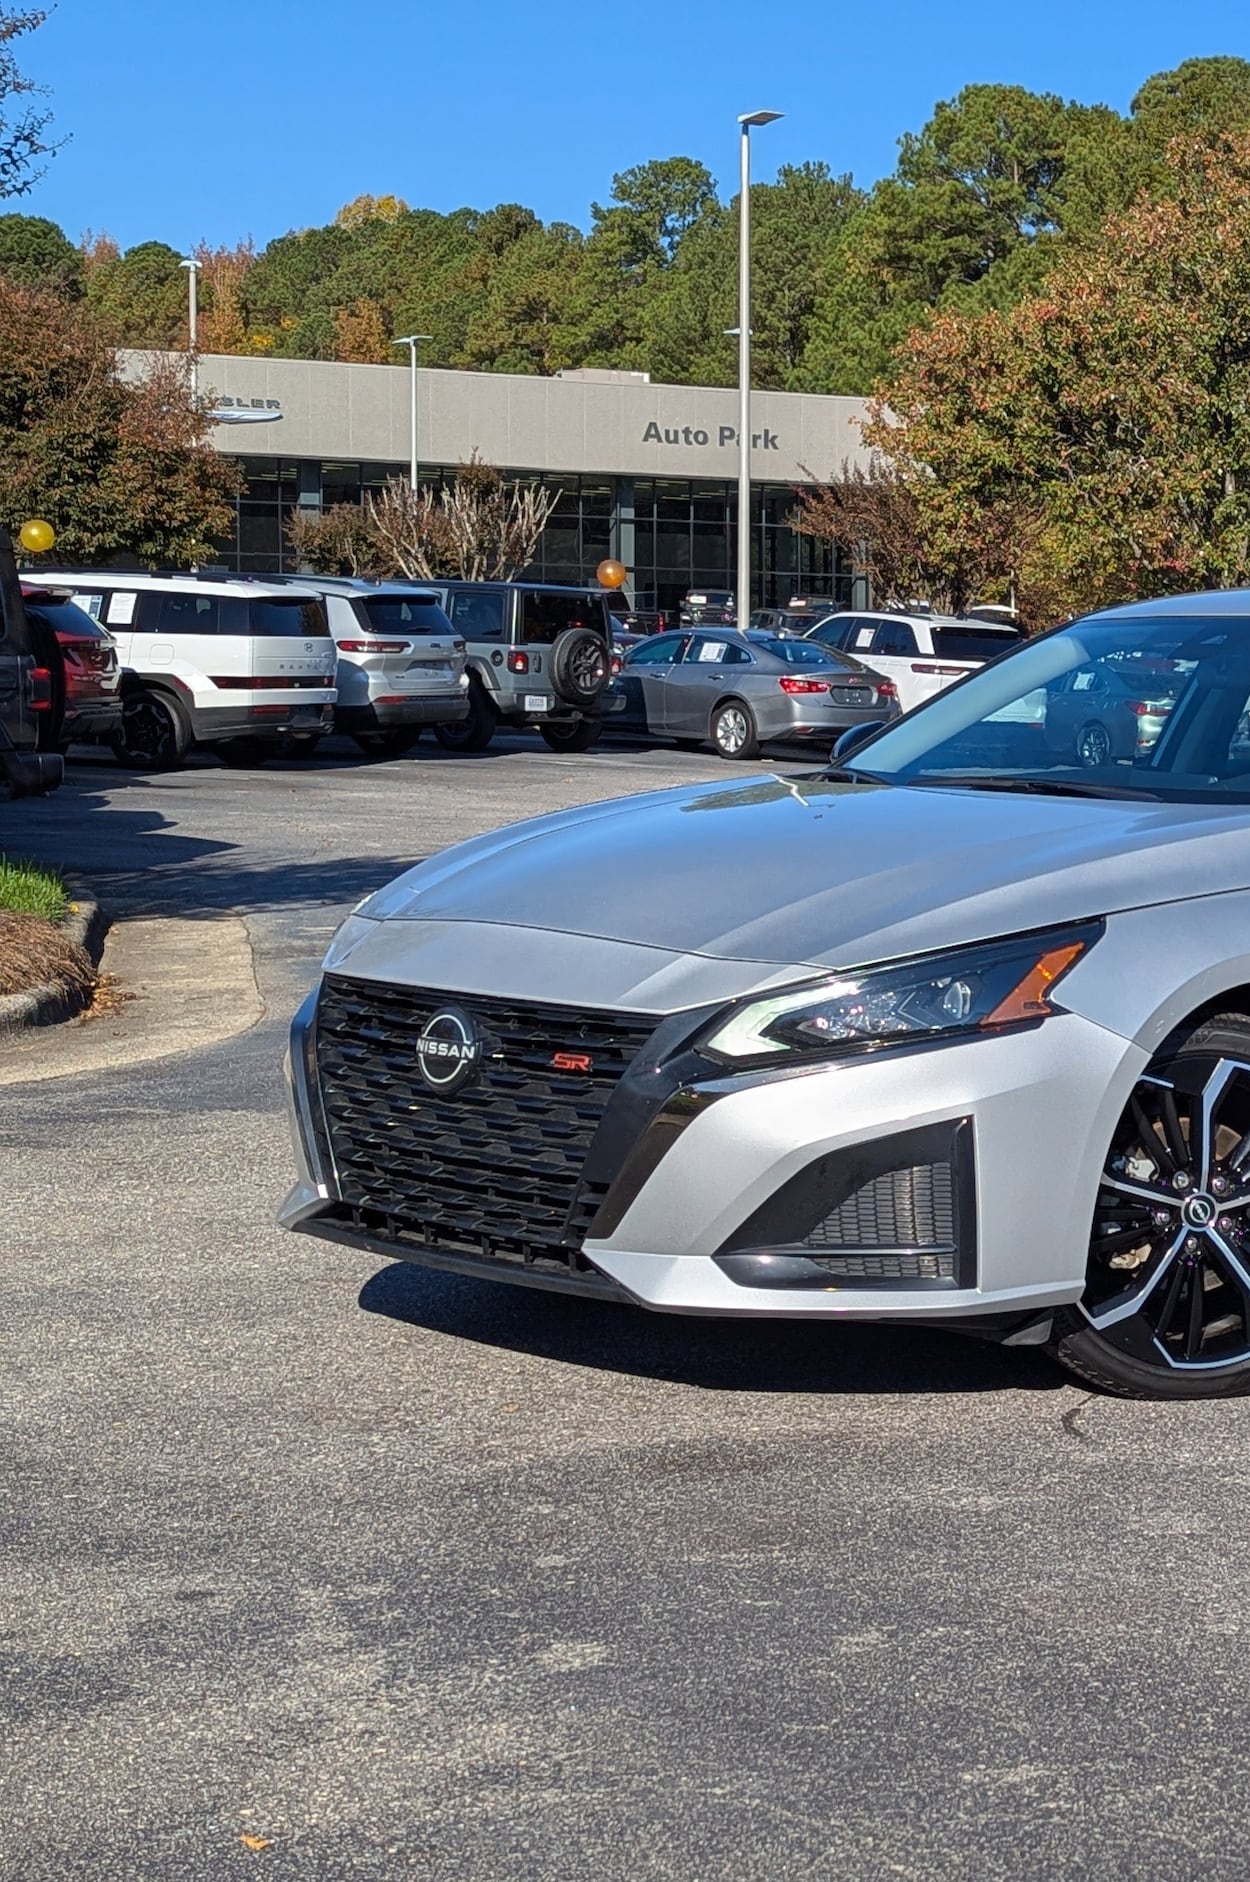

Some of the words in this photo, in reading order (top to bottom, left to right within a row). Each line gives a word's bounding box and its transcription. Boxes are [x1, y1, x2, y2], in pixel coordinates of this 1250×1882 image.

[642, 421, 709, 446] Auto
[718, 426, 779, 450] Prk
[416, 1038, 475, 1059] NISSAN
[553, 1052, 592, 1071] SR
